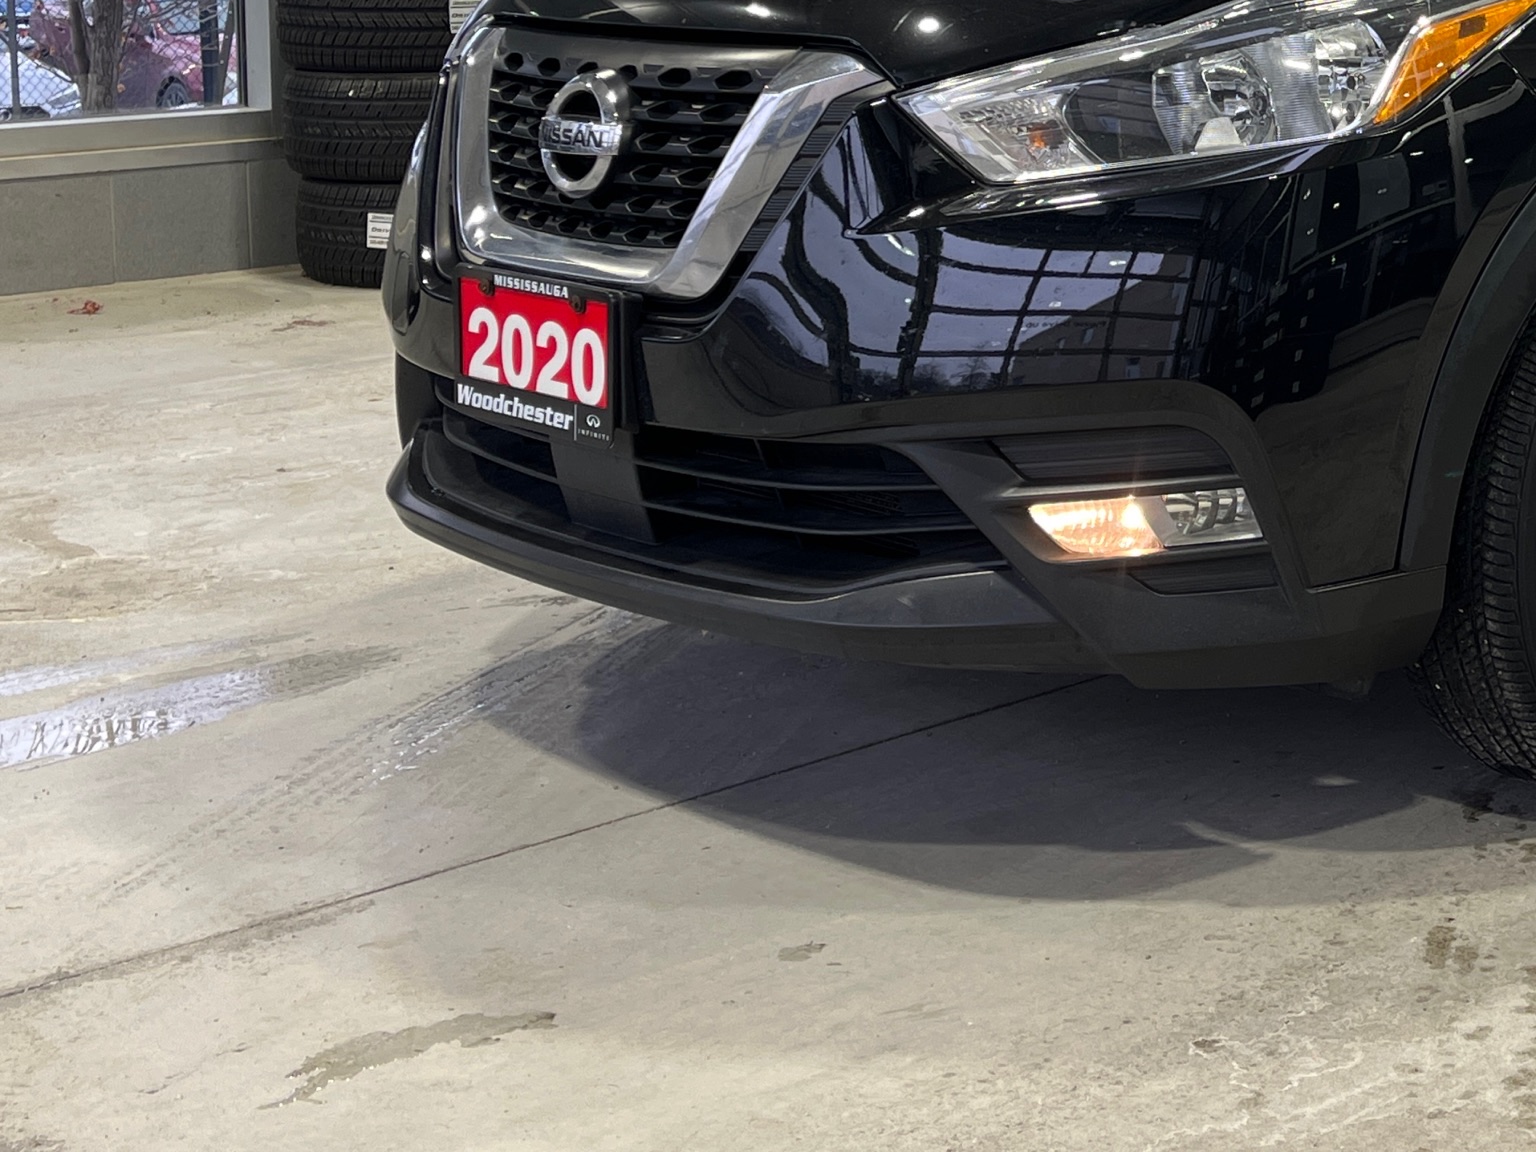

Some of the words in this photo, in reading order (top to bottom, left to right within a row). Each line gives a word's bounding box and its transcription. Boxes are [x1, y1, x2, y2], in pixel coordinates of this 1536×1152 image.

[493, 274, 569, 299] MISSISSAUGA
[467, 307, 606, 406] 2020
[457, 383, 574, 431] Woodchester
